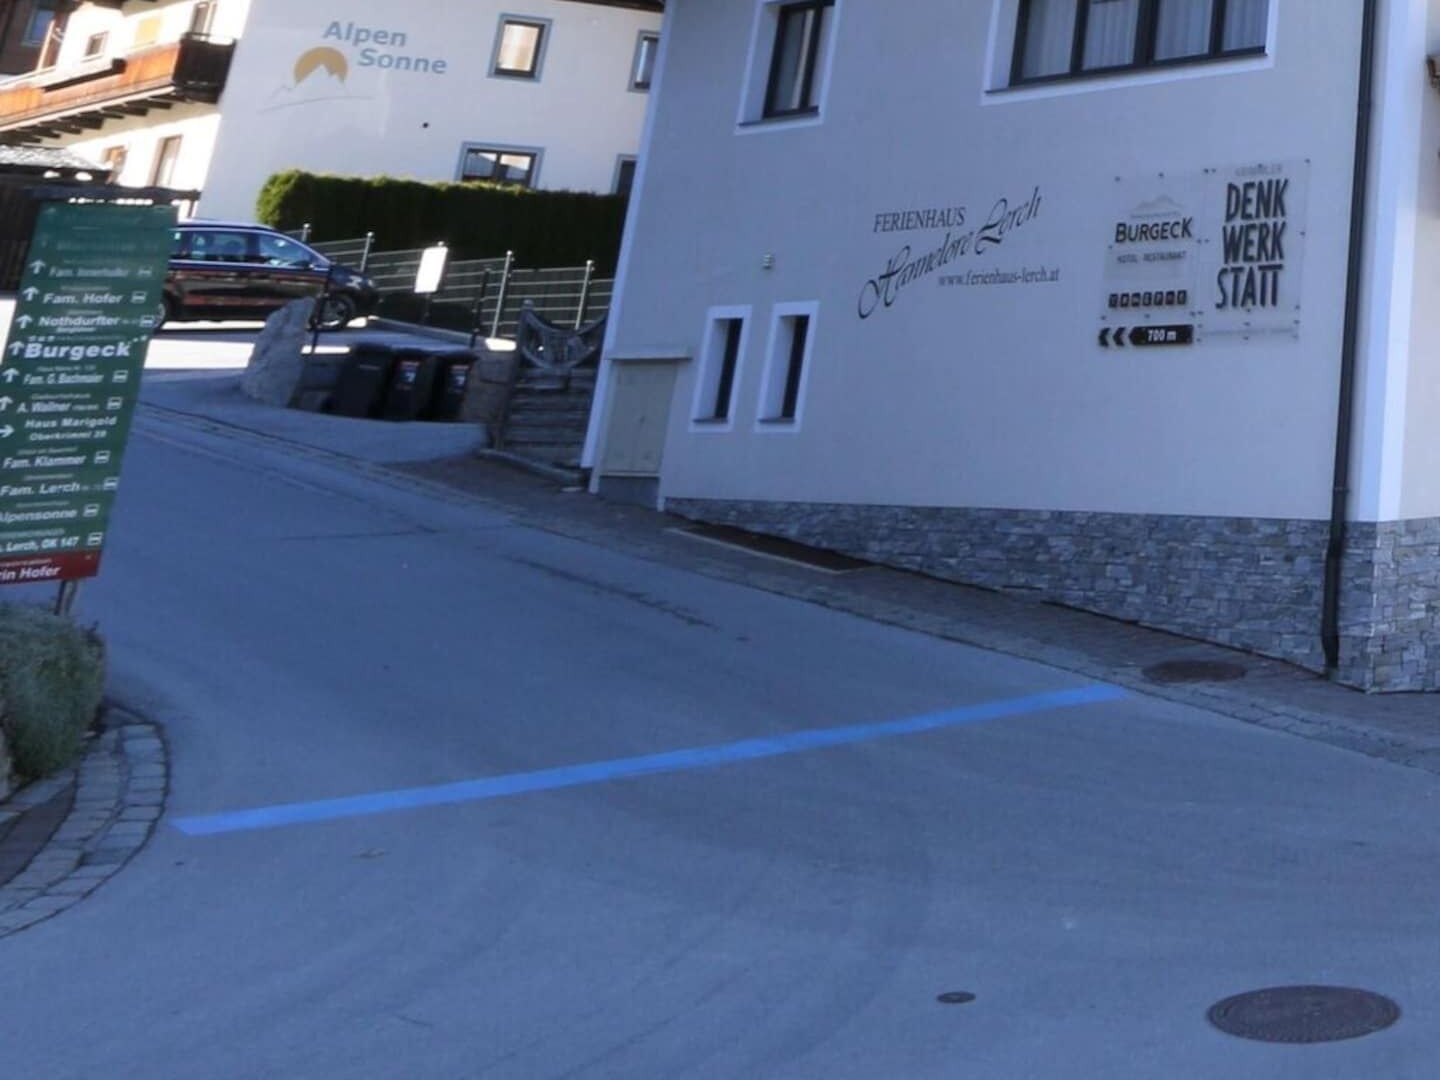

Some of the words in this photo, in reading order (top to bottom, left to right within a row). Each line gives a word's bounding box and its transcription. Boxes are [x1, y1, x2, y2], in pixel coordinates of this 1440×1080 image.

[323, 21, 407, 47] Alpen
[357, 47, 447, 74] Sonne
[1225, 178, 1289, 222] DENK
[873, 207, 967, 233] FERIENHAUS
[1115, 217, 1193, 243] BURGECK
[1222, 222, 1287, 264] WERK
[937, 266, 1060, 287] www.ferienhaus-lerch.at
[1215, 263, 1284, 309] STATT
[42, 293, 79, 304] Fam.
[83, 292, 124, 304] Hofer
[1147, 328, 1166, 342] 700
[1166, 330, 1176, 341] m
[24, 341, 130, 360] Burgeck
[24, 419, 58, 429] Haus
[2, 457, 32, 469] Fam.
[0, 485, 34, 497] Fam.
[39, 482, 80, 495] Lerch
[19, 565, 62, 578] Hofer
